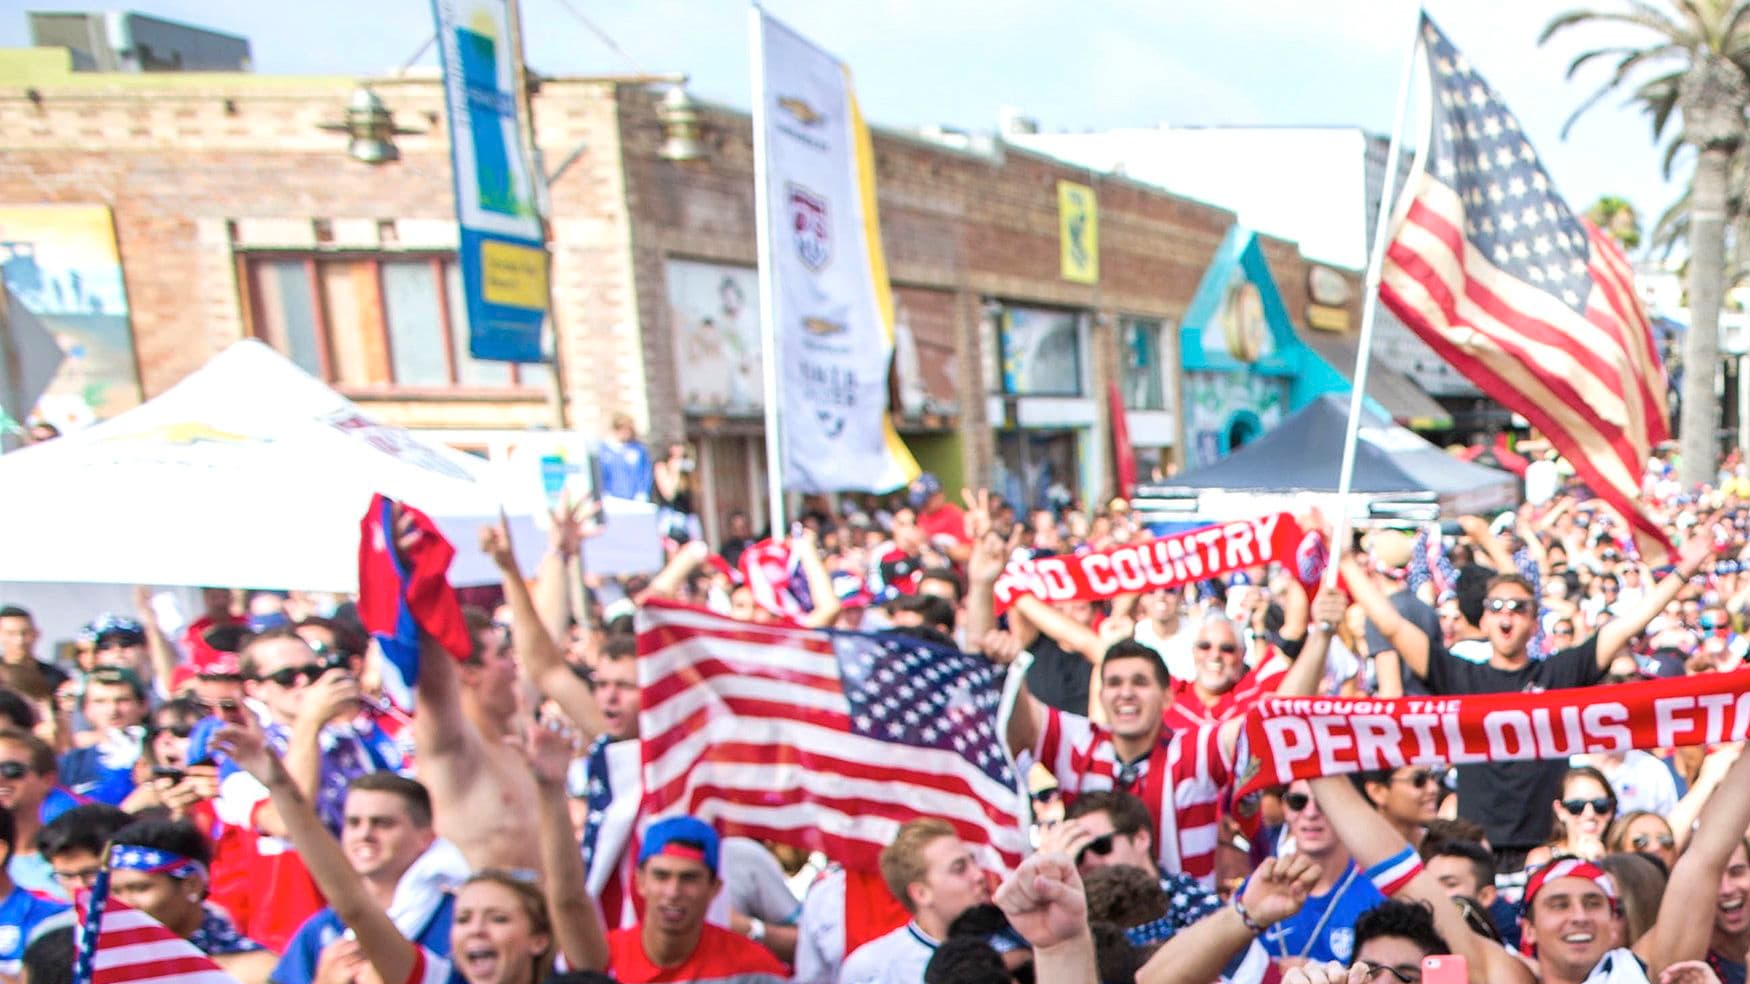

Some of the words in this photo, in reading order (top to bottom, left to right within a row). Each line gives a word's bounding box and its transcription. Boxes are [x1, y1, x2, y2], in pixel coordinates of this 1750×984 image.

[1080, 513, 1279, 594] COUNTRY
[1257, 699, 1396, 719] THROUGH
[1407, 699, 1462, 714] THE
[1261, 702, 1634, 785] PERILOUS
